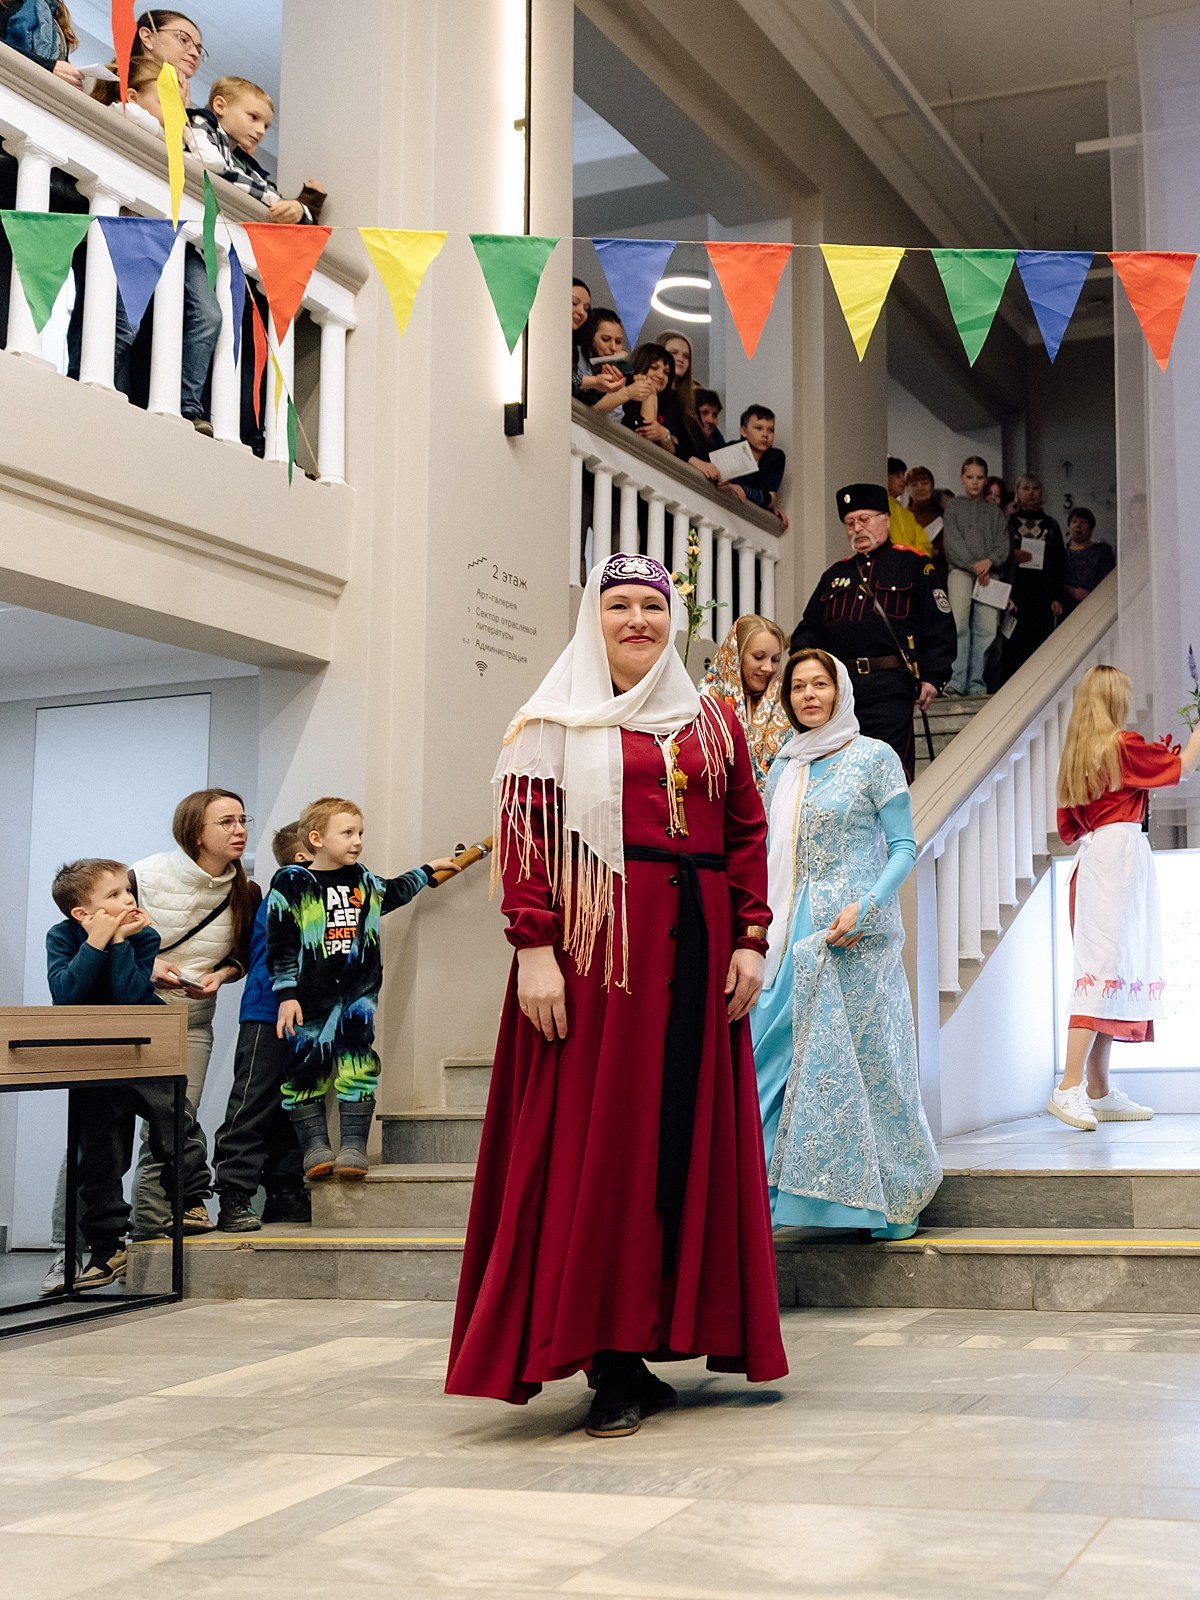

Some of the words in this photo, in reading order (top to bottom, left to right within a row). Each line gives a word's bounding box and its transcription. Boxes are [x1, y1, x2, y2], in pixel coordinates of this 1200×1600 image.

[1063, 494, 1072, 509] 3
[492, 564, 499, 580] 2
[502, 571, 528, 590] этаж
[476, 587, 518, 611] Арт-галерея
[475, 606, 500, 623] Сектор
[500, 617, 537, 636] отраслевой
[475, 622, 514, 641] литературы
[475, 638, 528, 663] Администрация
[326, 885, 350, 910] AT
